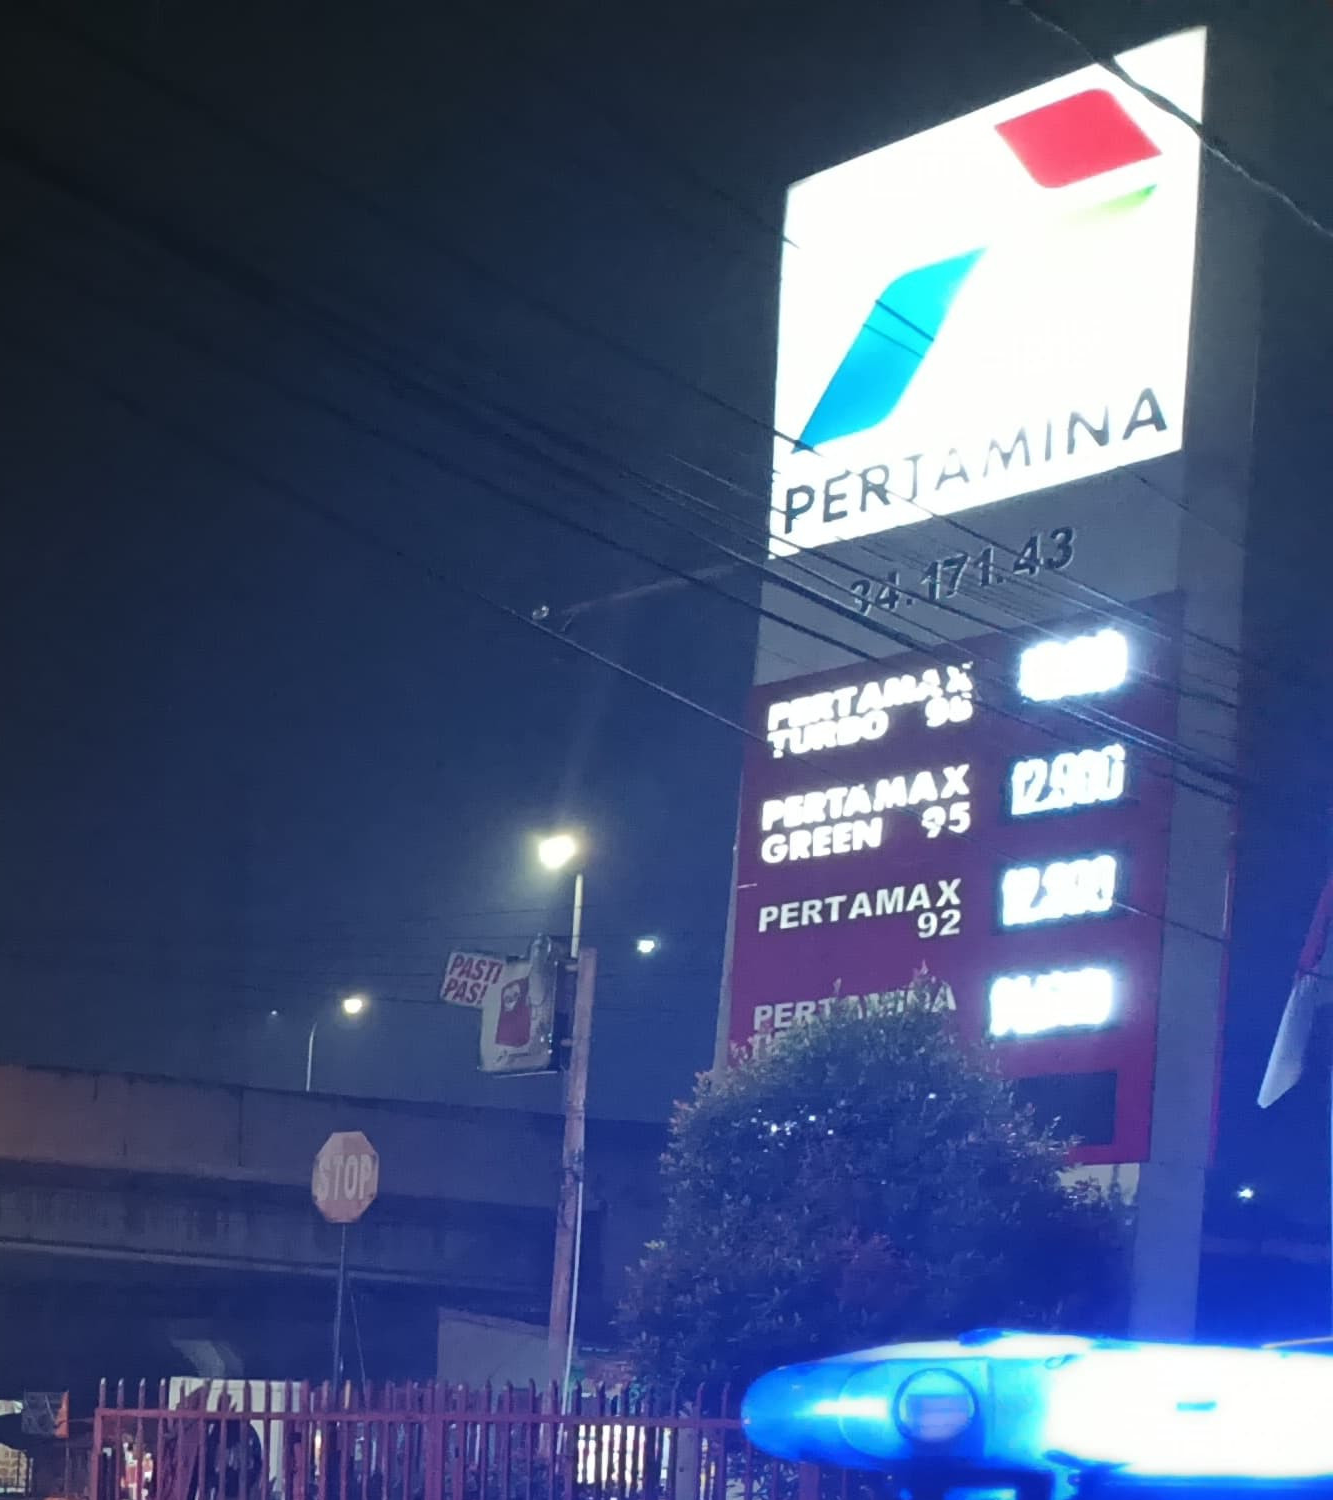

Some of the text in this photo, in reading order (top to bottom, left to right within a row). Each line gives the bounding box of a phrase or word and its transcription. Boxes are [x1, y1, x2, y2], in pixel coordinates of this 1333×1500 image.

[784, 386, 1169, 535] PERTAMINA
[850, 526, 1076, 617] 34.171.43
[767, 662, 974, 732] PERTAMAX
[767, 708, 889, 758] TURBO
[761, 763, 971, 831] PERTAMAX
[761, 801, 972, 864] GREEN 95
[758, 878, 962, 933] PERTAMAX
[917, 909, 962, 938] 92
[449, 954, 503, 984] PASTI
[317, 1154, 373, 1201] STOP
